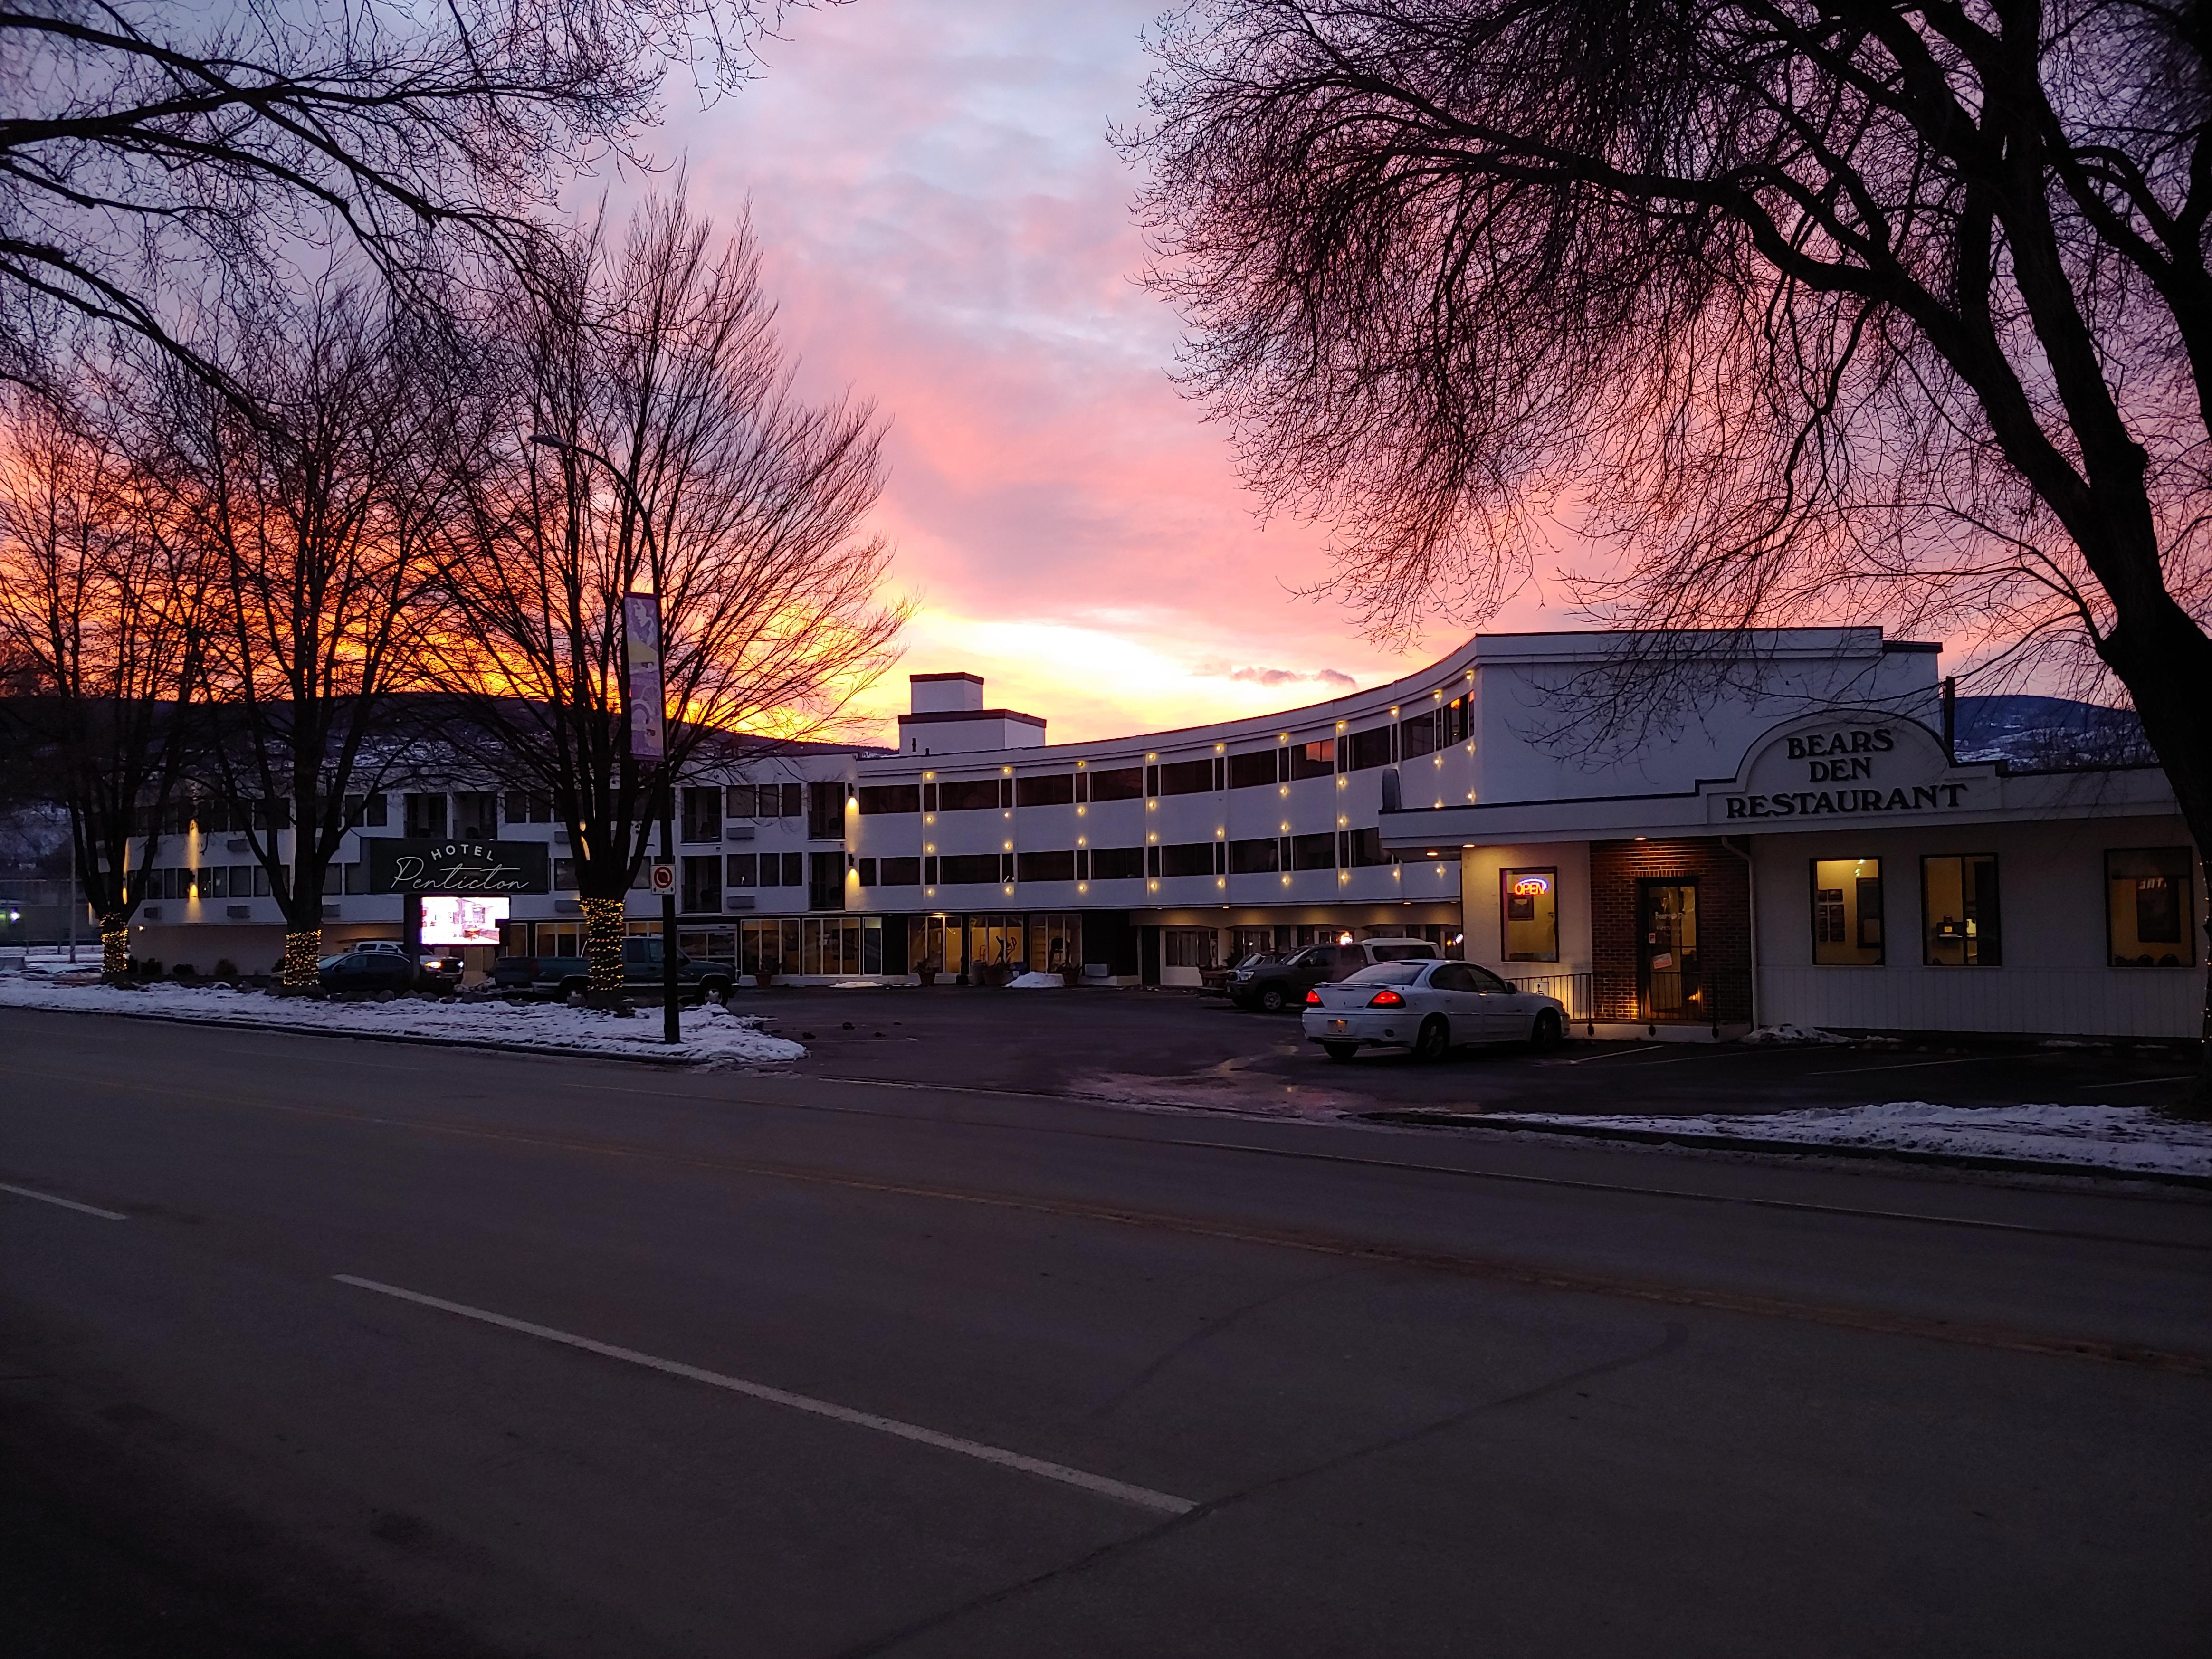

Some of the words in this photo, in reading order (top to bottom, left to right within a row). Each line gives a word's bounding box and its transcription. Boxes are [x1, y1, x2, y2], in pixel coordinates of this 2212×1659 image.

[1786, 728, 1894, 760] BEARS
[1809, 756, 1871, 782] DEN
[1726, 783, 1967, 819] RESTAURANT
[430, 844, 494, 862] HOTEL
[390, 856, 529, 890] Penticton
[1514, 882, 1545, 895] OPEN
